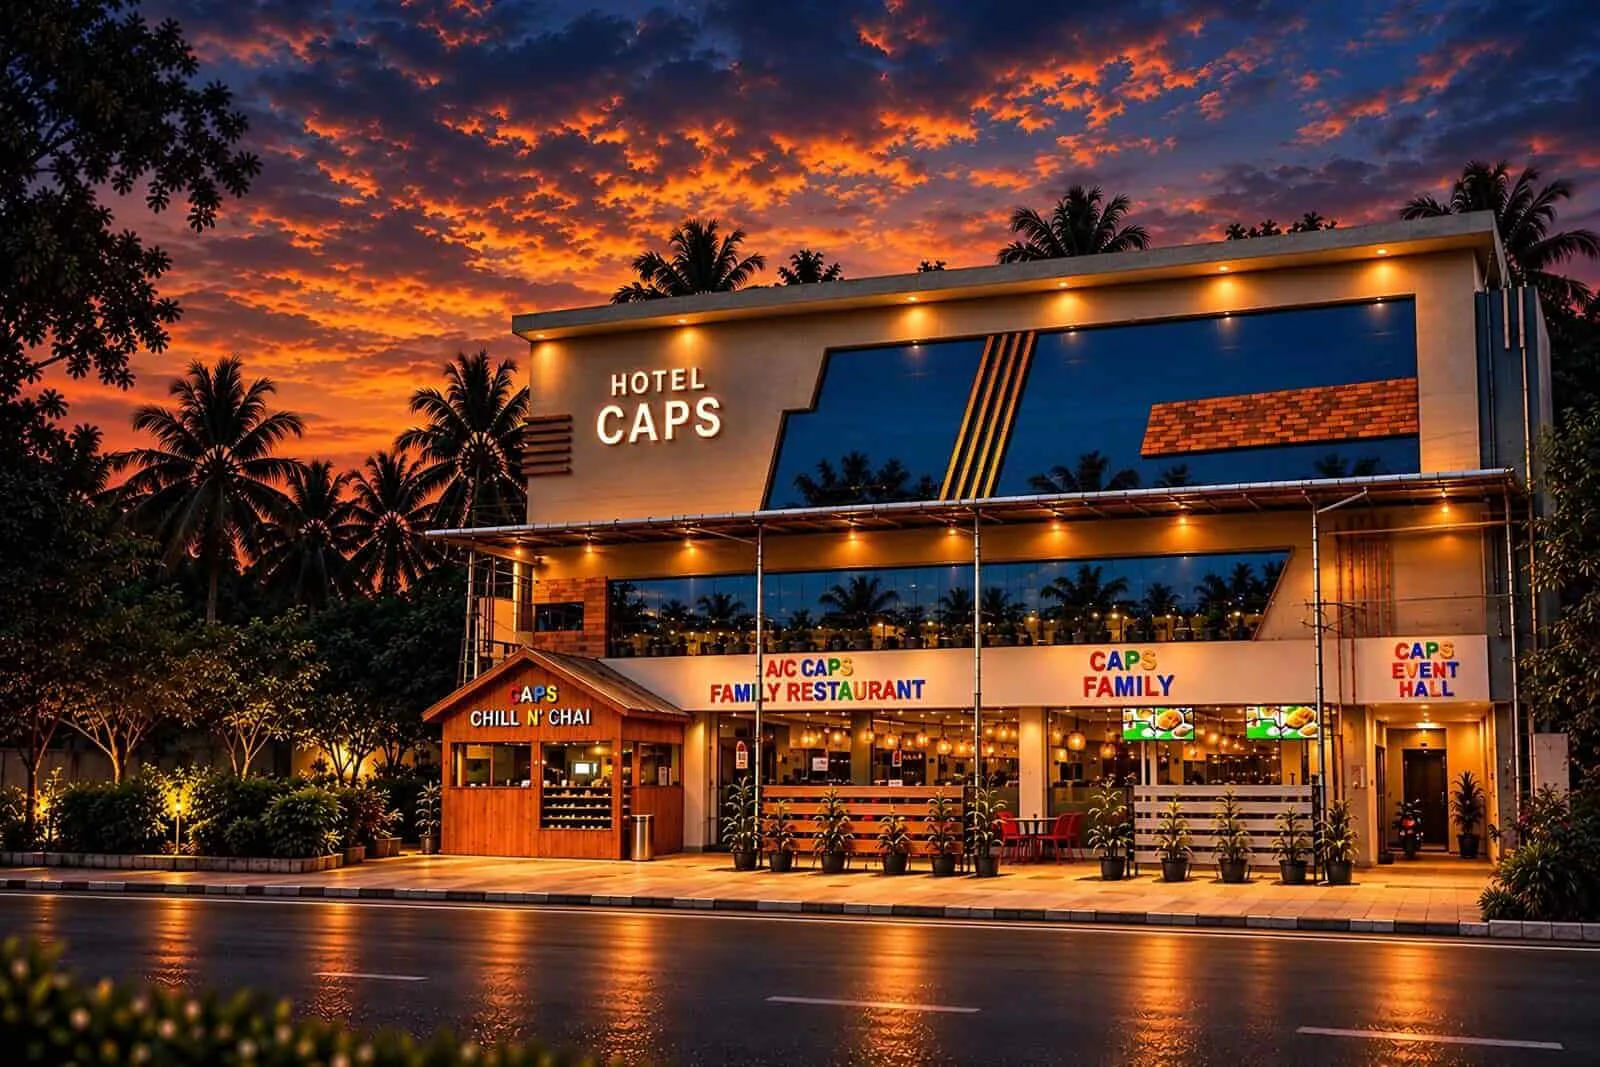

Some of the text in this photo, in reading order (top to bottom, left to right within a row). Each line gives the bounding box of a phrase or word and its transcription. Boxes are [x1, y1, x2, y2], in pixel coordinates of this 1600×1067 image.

[611, 367, 705, 396] HOTEL
[597, 397, 721, 445] CAPS
[1089, 650, 1157, 672] CAPS
[1395, 642, 1454, 660] CAPS
[765, 658, 853, 678] A/C CAPS
[1392, 661, 1459, 679] EVENT
[786, 680, 926, 702] RESTAURANT
[1083, 675, 1174, 698] FAMILY
[1399, 680, 1455, 698] HALL
[470, 710, 520, 727] CHILL
[548, 708, 591, 726] CHAI
